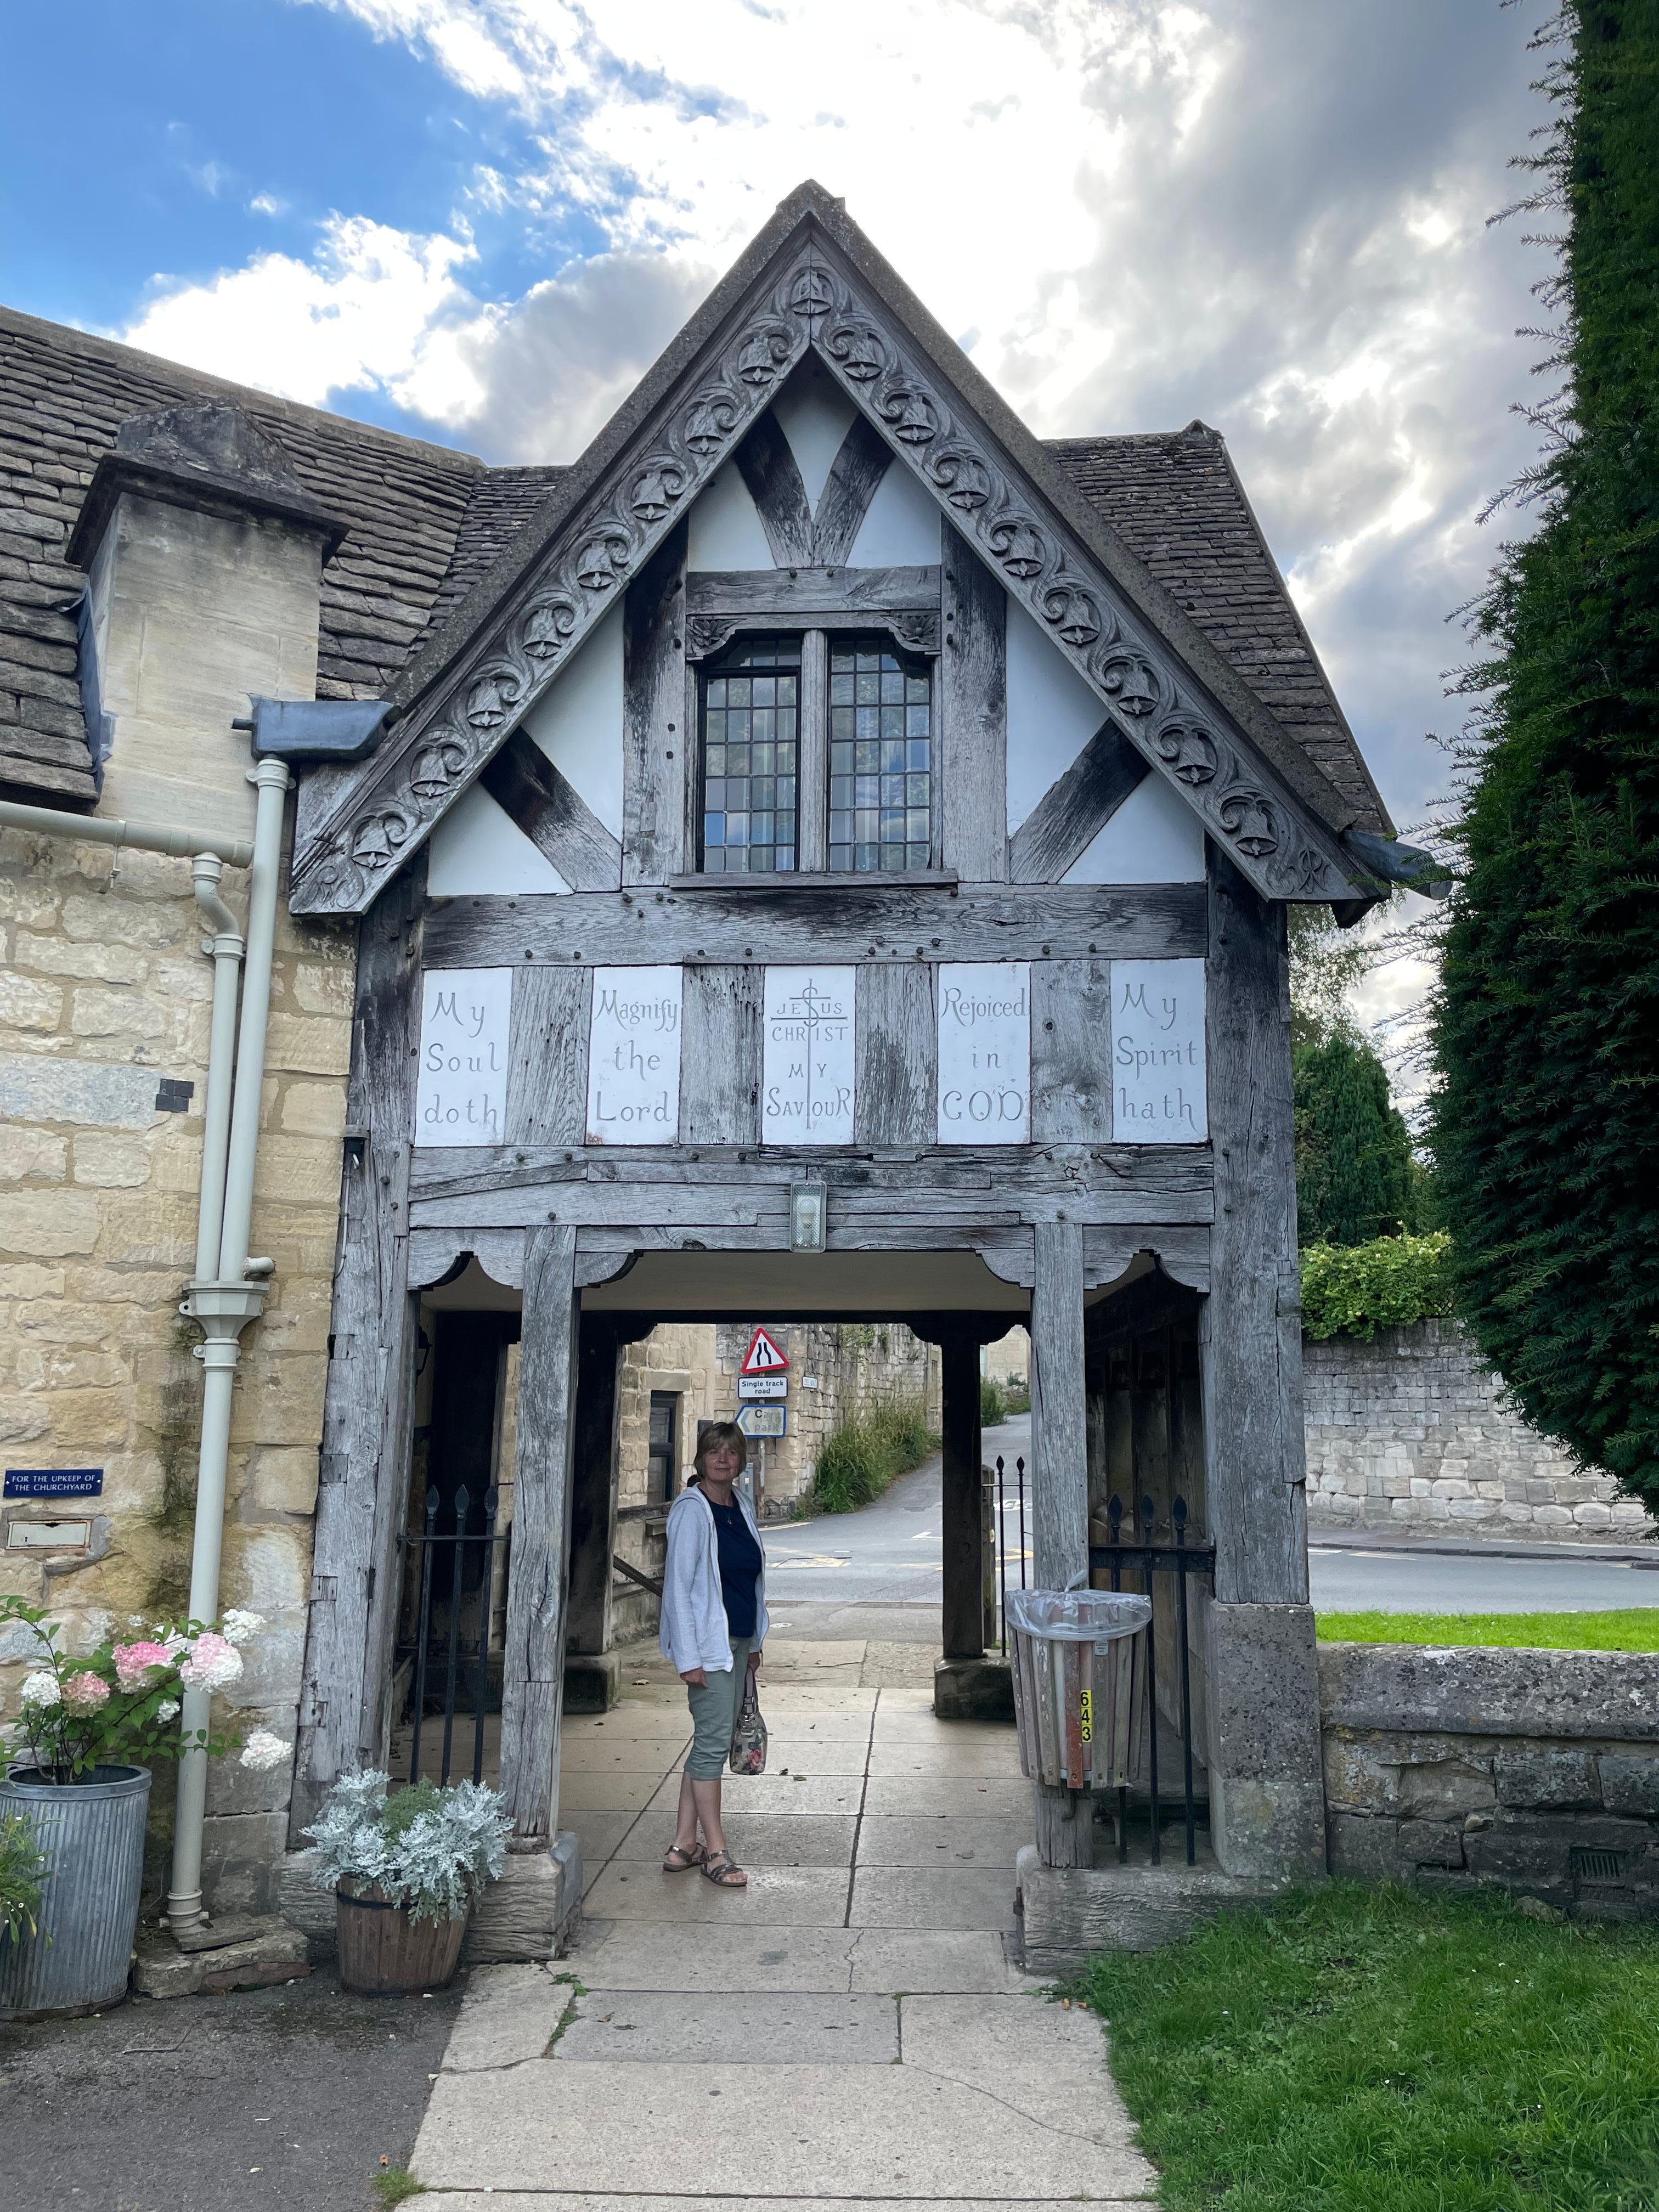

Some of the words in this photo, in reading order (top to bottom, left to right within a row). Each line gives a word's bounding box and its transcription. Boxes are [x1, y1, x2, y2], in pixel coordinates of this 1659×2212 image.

[430, 992, 485, 1038] My
[594, 989, 678, 1032] Magnify
[776, 987, 843, 1028] JESUS
[940, 987, 1026, 1027] Rejoiced
[1119, 983, 1177, 1031] My
[772, 1026, 849, 1042] CHRIST
[426, 1042, 501, 1072] Soul
[614, 1040, 661, 1081] the
[788, 1063, 827, 1079] MY
[971, 1046, 1001, 1069] in
[1116, 1036, 1198, 1081] Spirit
[424, 1093, 498, 1134] doth
[596, 1091, 673, 1122] Lord
[942, 1090, 1024, 1121] GOD
[1119, 1087, 1198, 1133] hath
[33, 1483, 92, 1491] CHURCHYARD
[1080, 1691, 1091, 1741] 643
